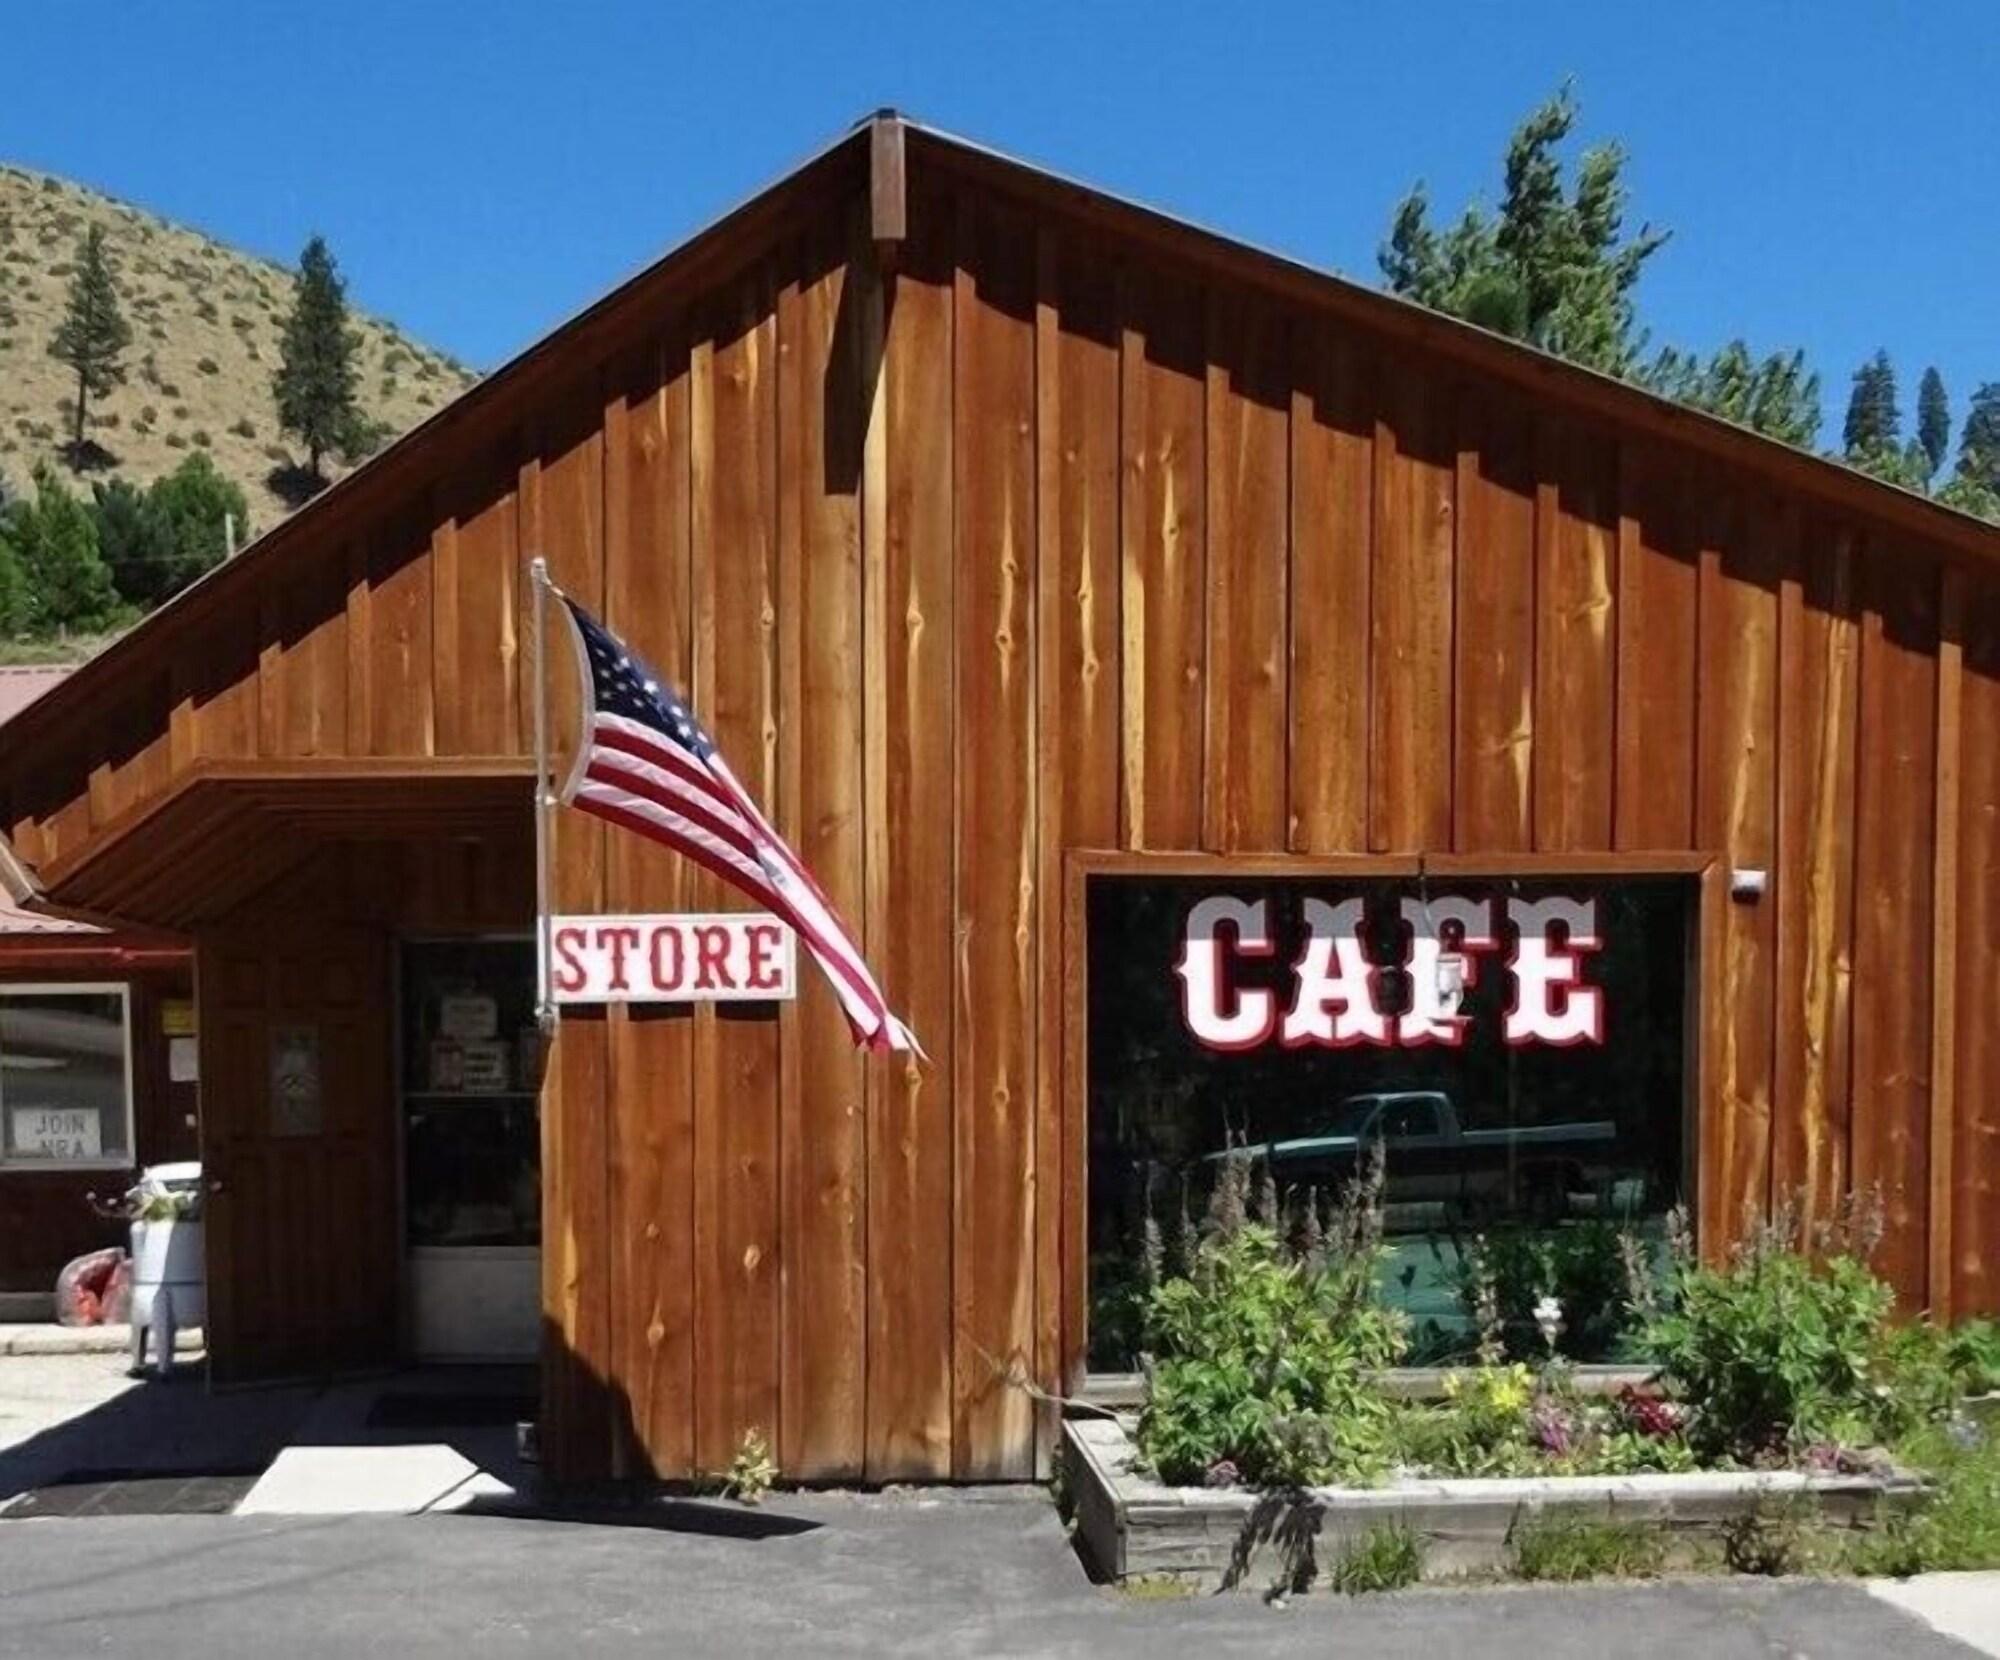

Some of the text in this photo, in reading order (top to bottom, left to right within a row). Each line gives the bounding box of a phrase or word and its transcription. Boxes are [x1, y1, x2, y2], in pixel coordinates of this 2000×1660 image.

[554, 925, 783, 992] STORE
[1174, 895, 1606, 1051] CAFE
[35, 1114, 85, 1136] JOIN
[41, 1139, 86, 1159] NRA
